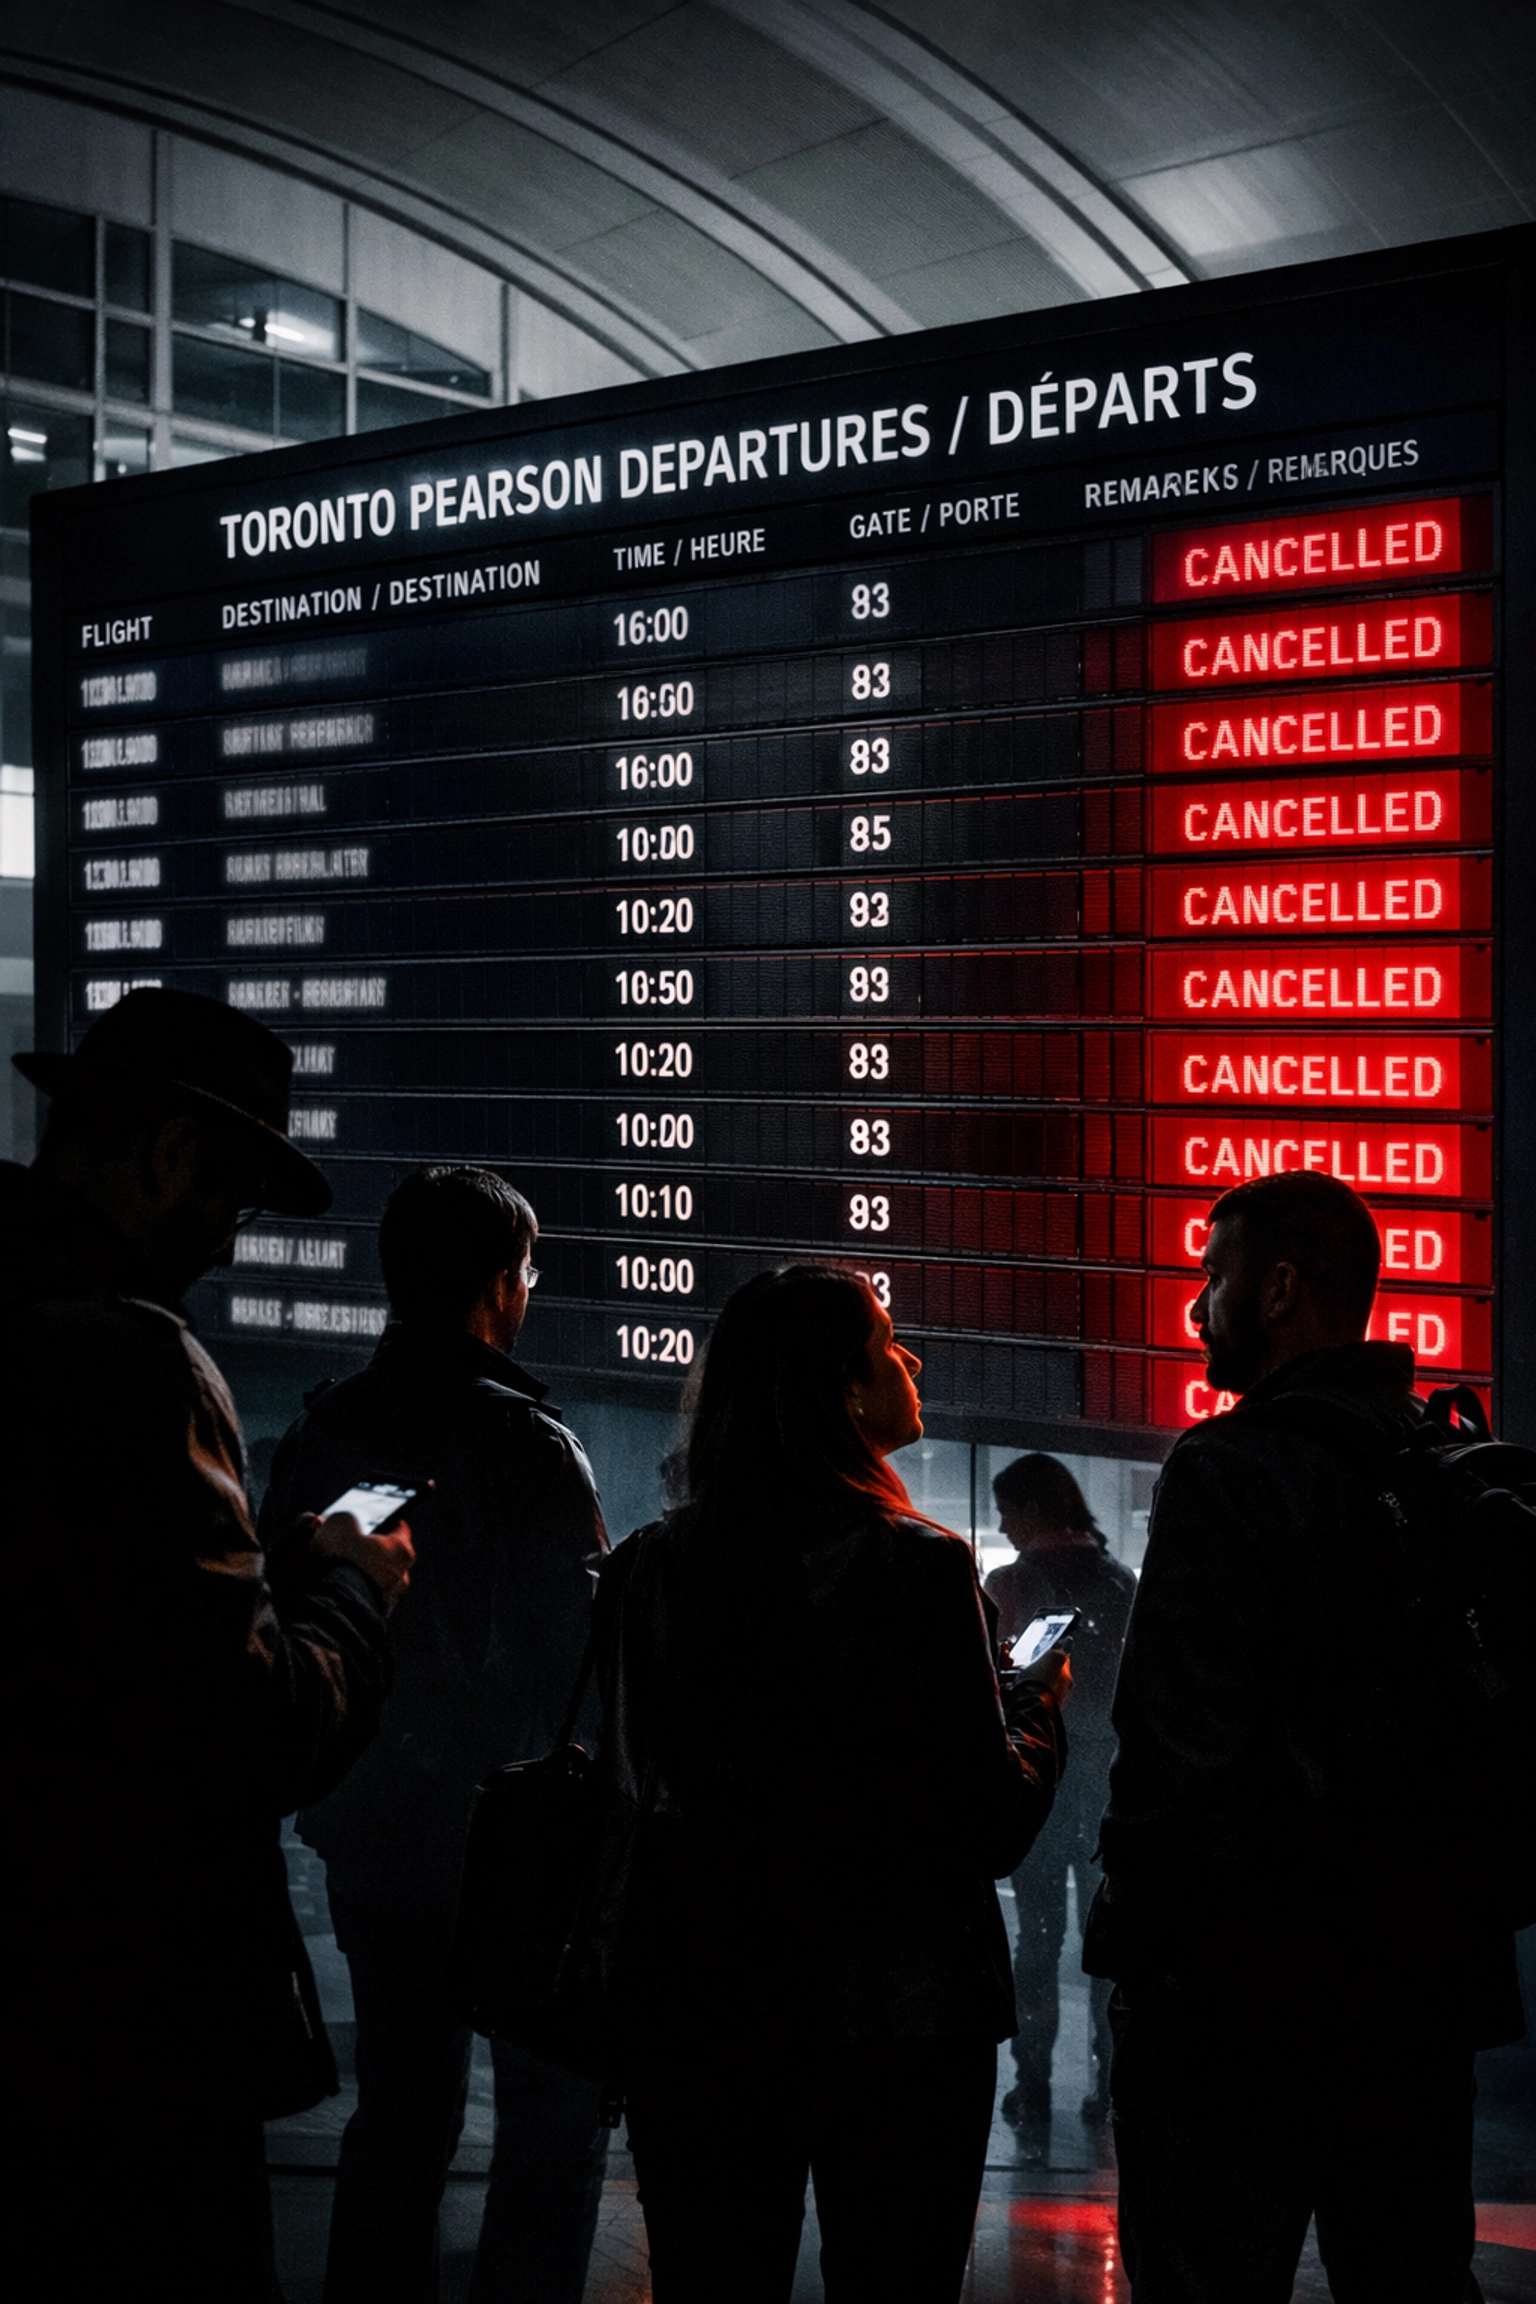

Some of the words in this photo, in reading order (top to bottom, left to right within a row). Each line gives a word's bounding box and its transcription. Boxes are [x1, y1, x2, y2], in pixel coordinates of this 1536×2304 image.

[220, 489, 395, 558] TORONTO
[410, 455, 602, 530] PEARSON
[620, 404, 930, 498] DEPARTURES
[949, 396, 968, 455] /
[990, 352, 1256, 445] DÉPARTS
[1248, 461, 1258, 489] /
[850, 508, 911, 538] GATE
[921, 505, 930, 532] /
[941, 493, 1019, 526] PORTE
[614, 543, 665, 570] TIME
[674, 540, 682, 565] /
[692, 529, 764, 560] HEURE
[1185, 521, 1441, 586] CANCELLED
[223, 587, 361, 628] DESTINATION
[372, 584, 380, 610] /
[390, 560, 539, 605] DESTINATION
[852, 583, 889, 619] 83
[83, 616, 152, 647] FLIGHT
[614, 606, 688, 646] 16:00
[1184, 617, 1441, 676] CANCELLED
[852, 663, 890, 700] 83
[1184, 705, 1441, 760] CANCELLED
[616, 752, 693, 790] 16:00
[850, 738, 889, 774] 83
[850, 815, 891, 851] 85
[1185, 791, 1441, 841] CANCELLED
[616, 898, 693, 934] 10:20
[1184, 879, 1442, 925] CANCELLED
[850, 967, 888, 1002] 83
[1184, 967, 1441, 1007] CANCELLED
[616, 1042, 692, 1077] 10:20
[849, 1043, 888, 1079] 83
[1184, 1055, 1442, 1097] CANCELLED
[850, 1119, 890, 1156] 83
[1185, 1137, 1443, 1184] CANCELLED
[616, 1184, 692, 1220] 10:10
[855, 1271, 891, 1309] 3
[617, 1325, 694, 1364] 10:20
